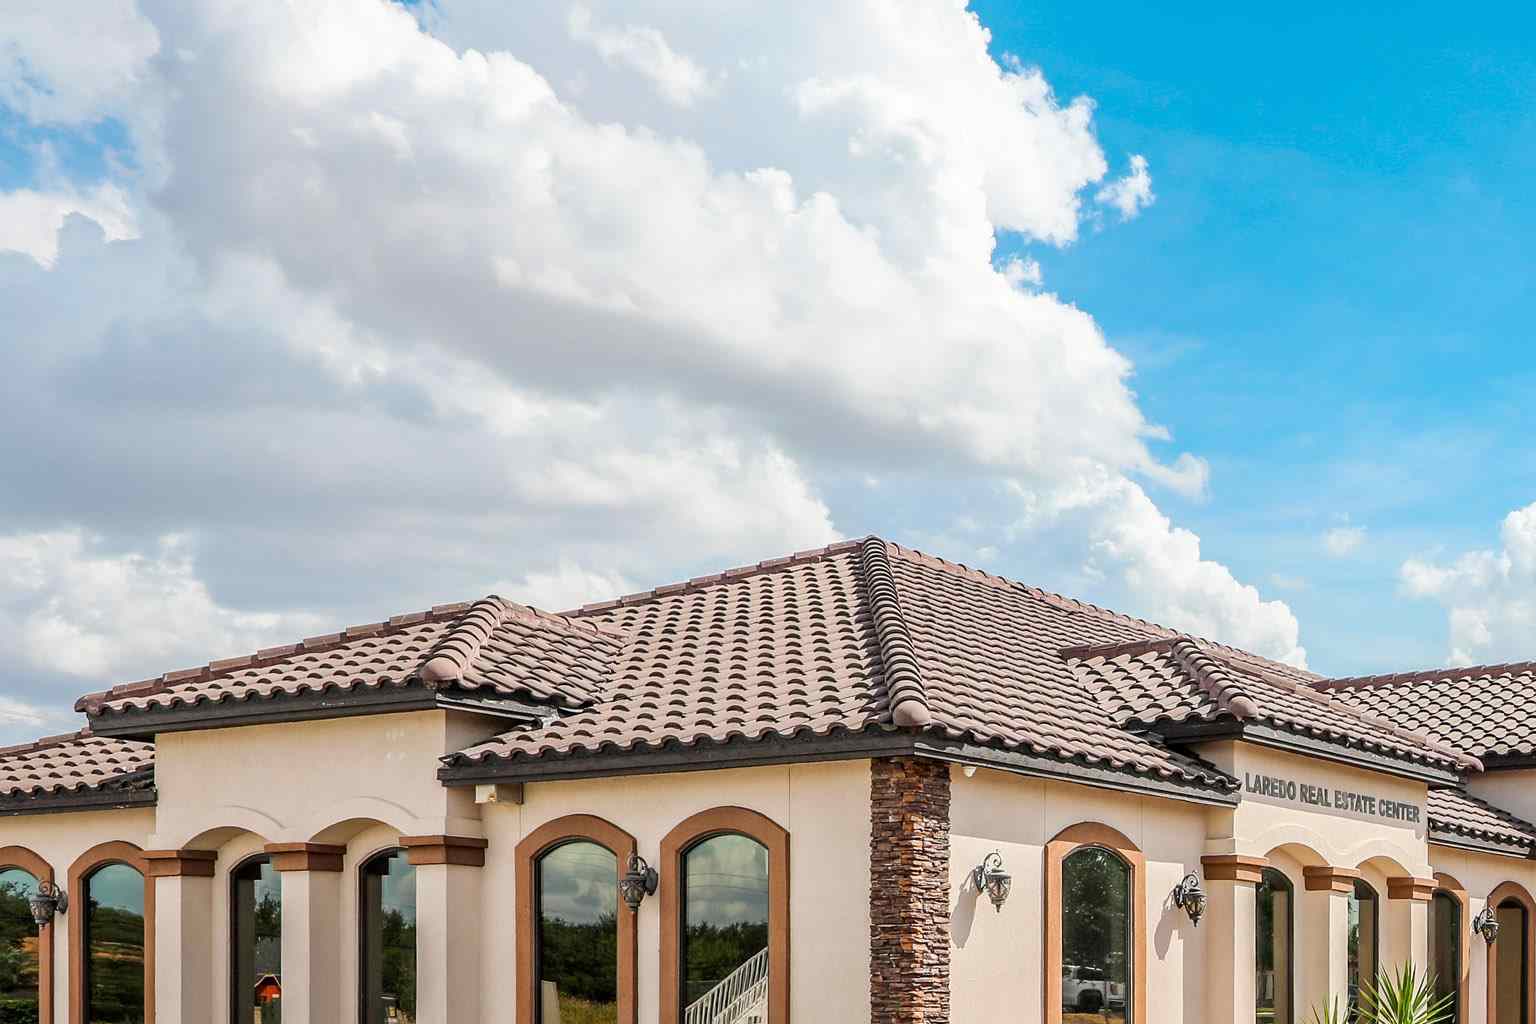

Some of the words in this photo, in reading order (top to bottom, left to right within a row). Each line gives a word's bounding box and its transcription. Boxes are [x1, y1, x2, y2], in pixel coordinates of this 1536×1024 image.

[1245, 772, 1297, 800] LAREDO
[1299, 783, 1332, 808] REAL
[1334, 791, 1376, 817] ESTATE
[1378, 799, 1420, 824] CENTER
